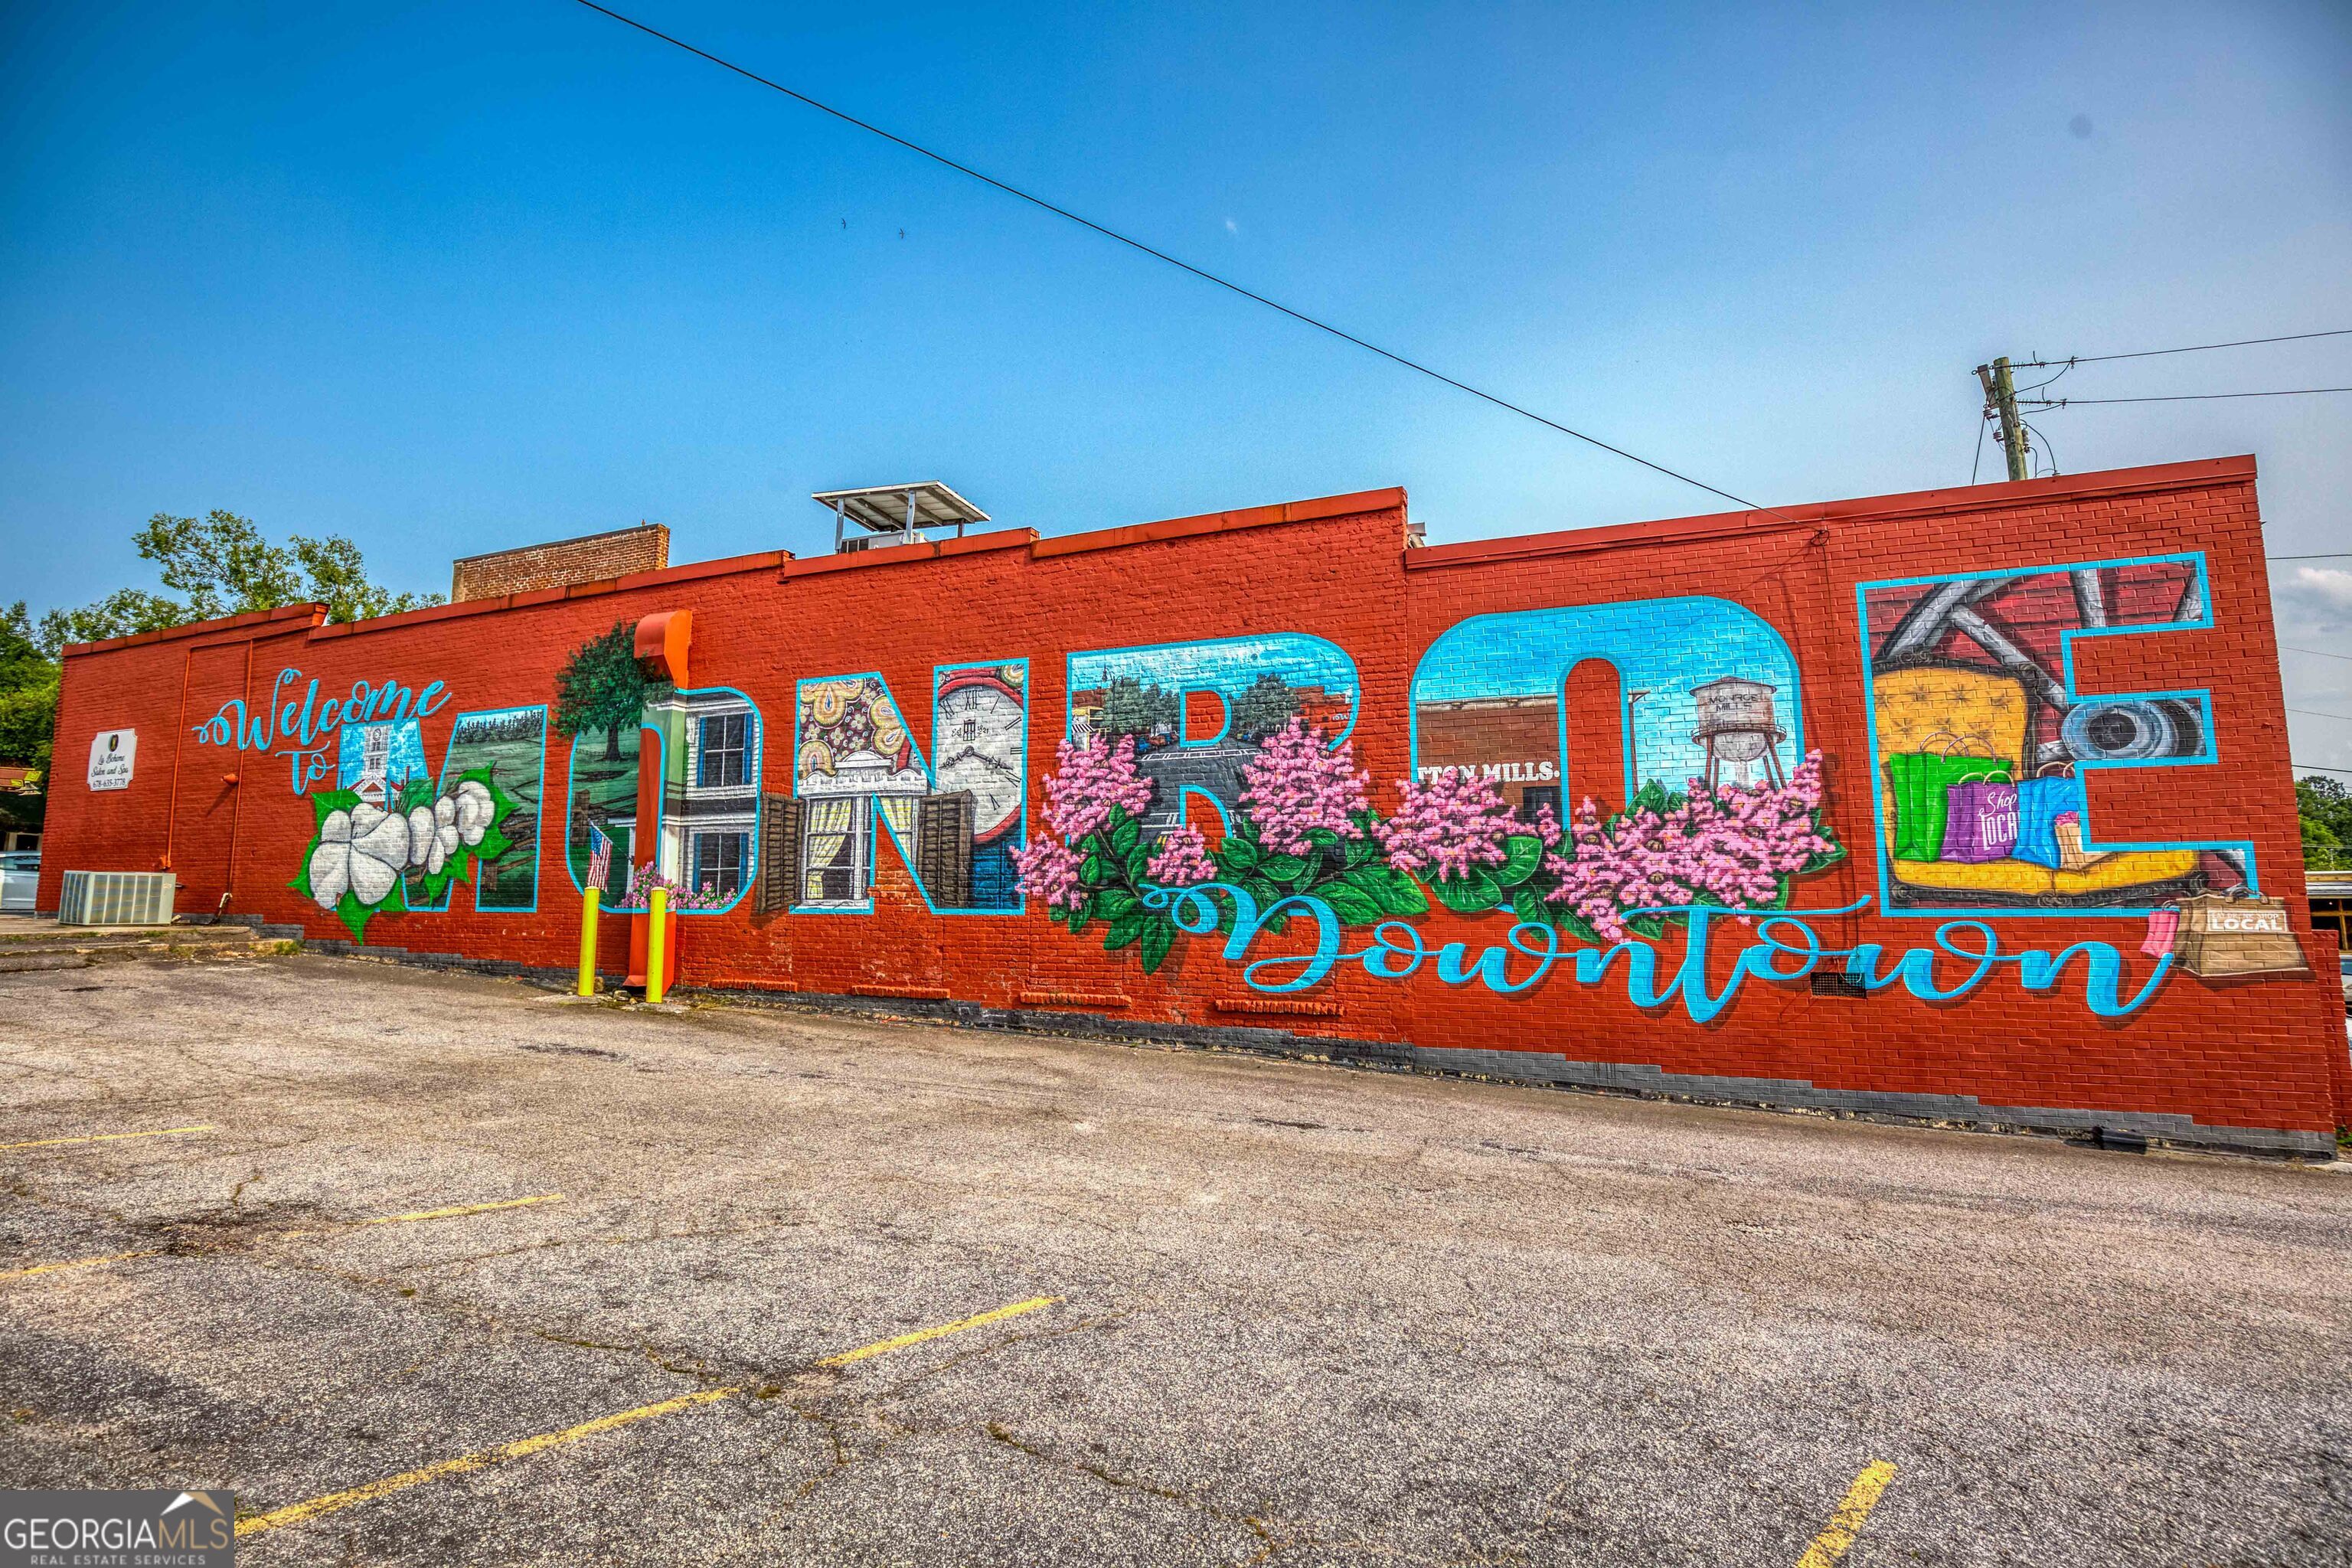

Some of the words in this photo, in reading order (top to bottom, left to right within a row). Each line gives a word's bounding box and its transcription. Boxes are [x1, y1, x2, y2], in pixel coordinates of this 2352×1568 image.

[191, 668, 452, 751] Welcome
[1709, 694, 1758, 704] MONROE
[91, 766, 105, 777] Salon
[106, 766, 117, 775] and
[118, 764, 128, 775] Spa
[275, 741, 335, 795] To
[1977, 791, 2017, 817] Shop
[1981, 809, 2021, 851] LOCA
[2211, 919, 2283, 930] LOCAL
